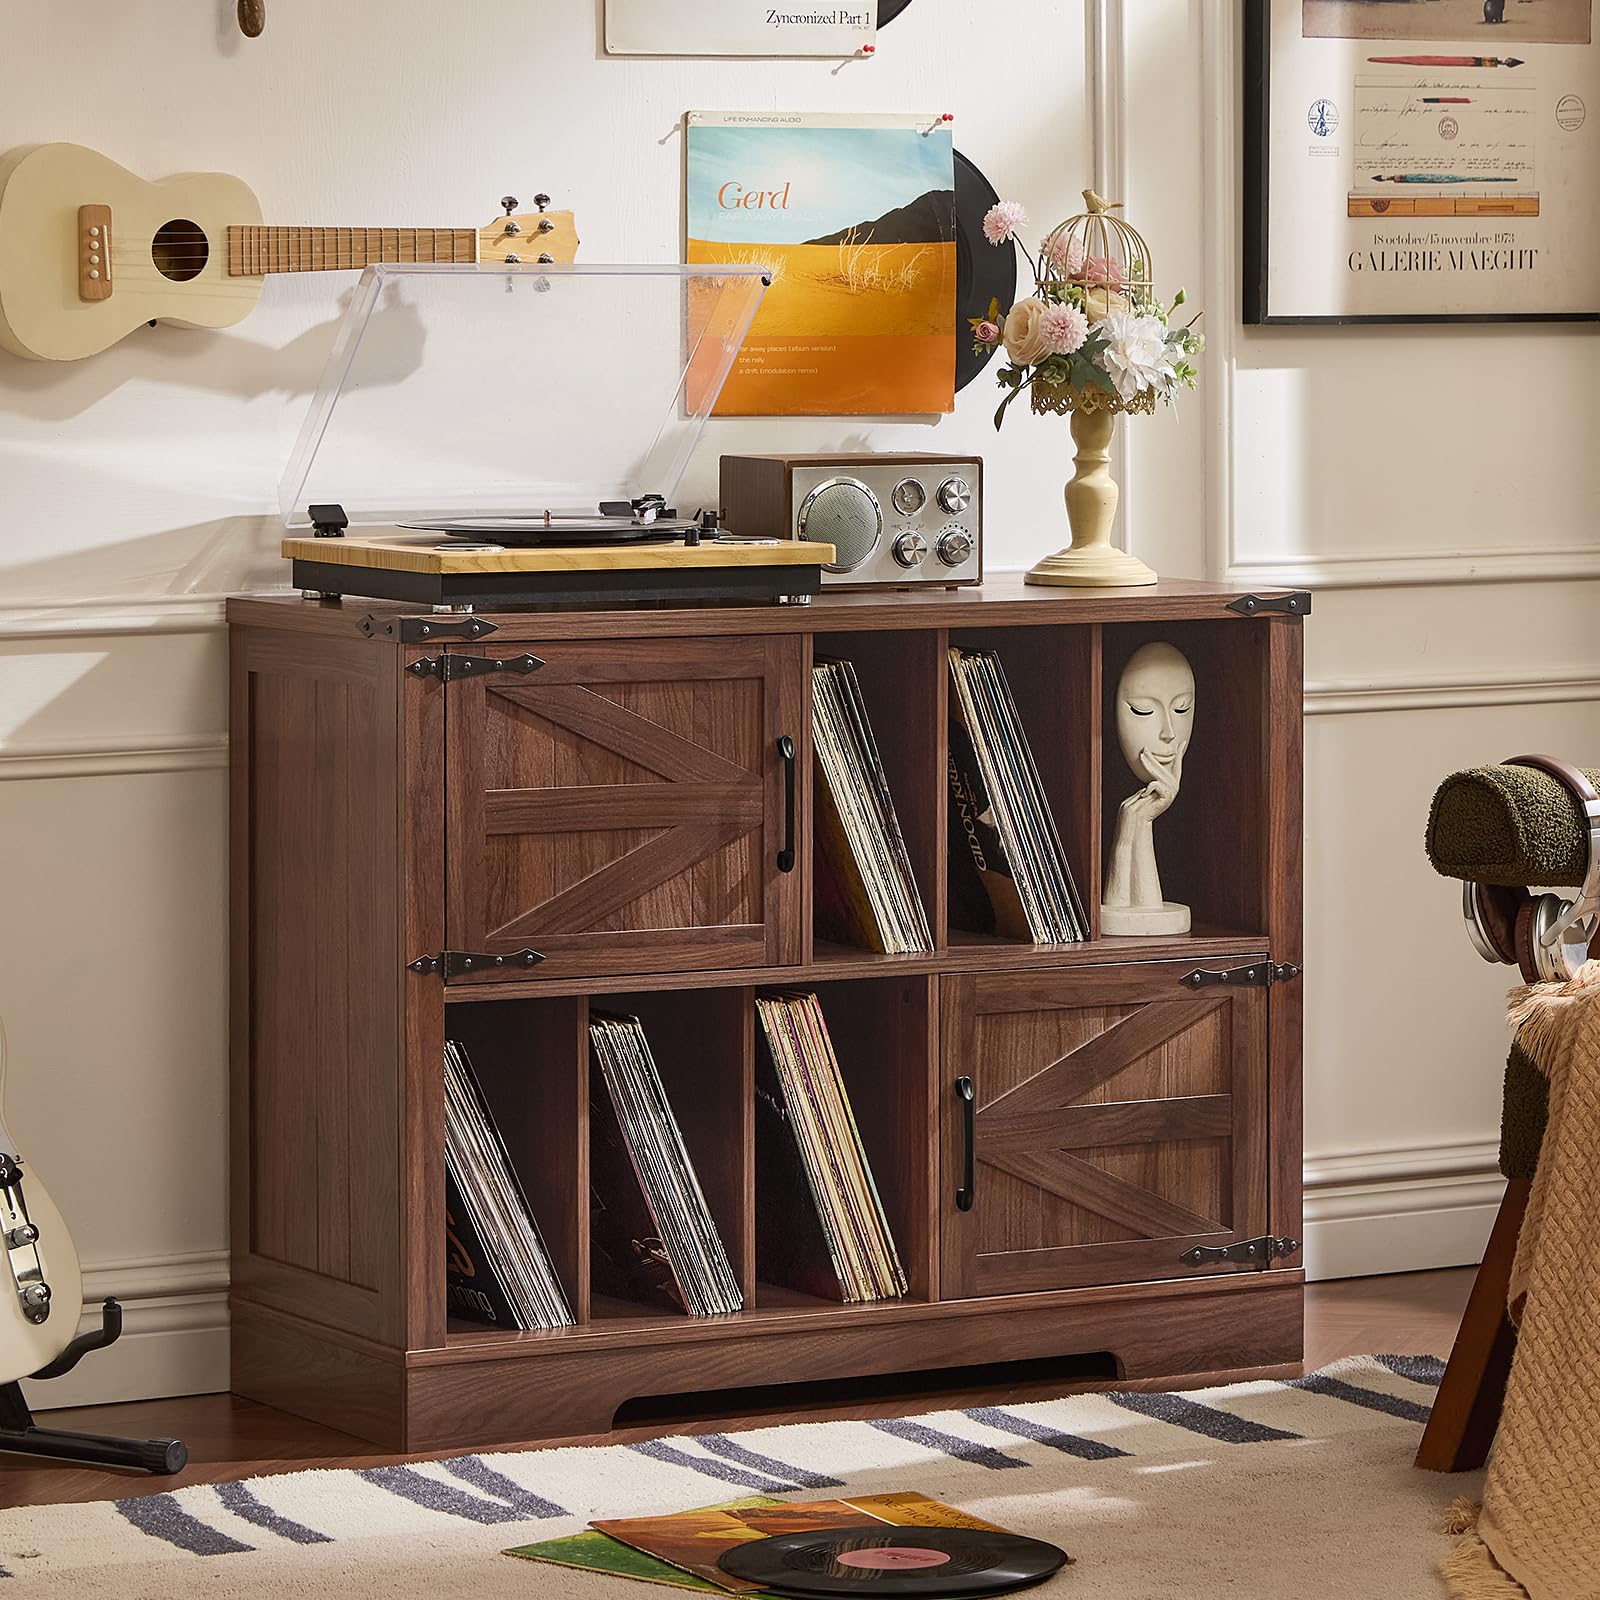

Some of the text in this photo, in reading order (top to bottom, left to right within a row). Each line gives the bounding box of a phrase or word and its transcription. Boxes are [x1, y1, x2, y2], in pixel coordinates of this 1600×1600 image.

[766, 9, 836, 28] Zyncronized
[839, 11, 862, 25] Part
[865, 12, 870, 25] 1
[718, 181, 791, 210] Gerd
[1374, 234, 1384, 246] 18
[1441, 232, 1493, 245] novembre
[1494, 232, 1515, 244] 1973
[1348, 249, 1538, 273] GALERIE MAEGHT
[749, 346, 766, 354] away
[766, 345, 787, 354] places
[788, 345, 810, 353] (album
[811, 344, 837, 353] version)
[797, 367, 818, 375] remix)
[960, 803, 986, 871] GIDON
